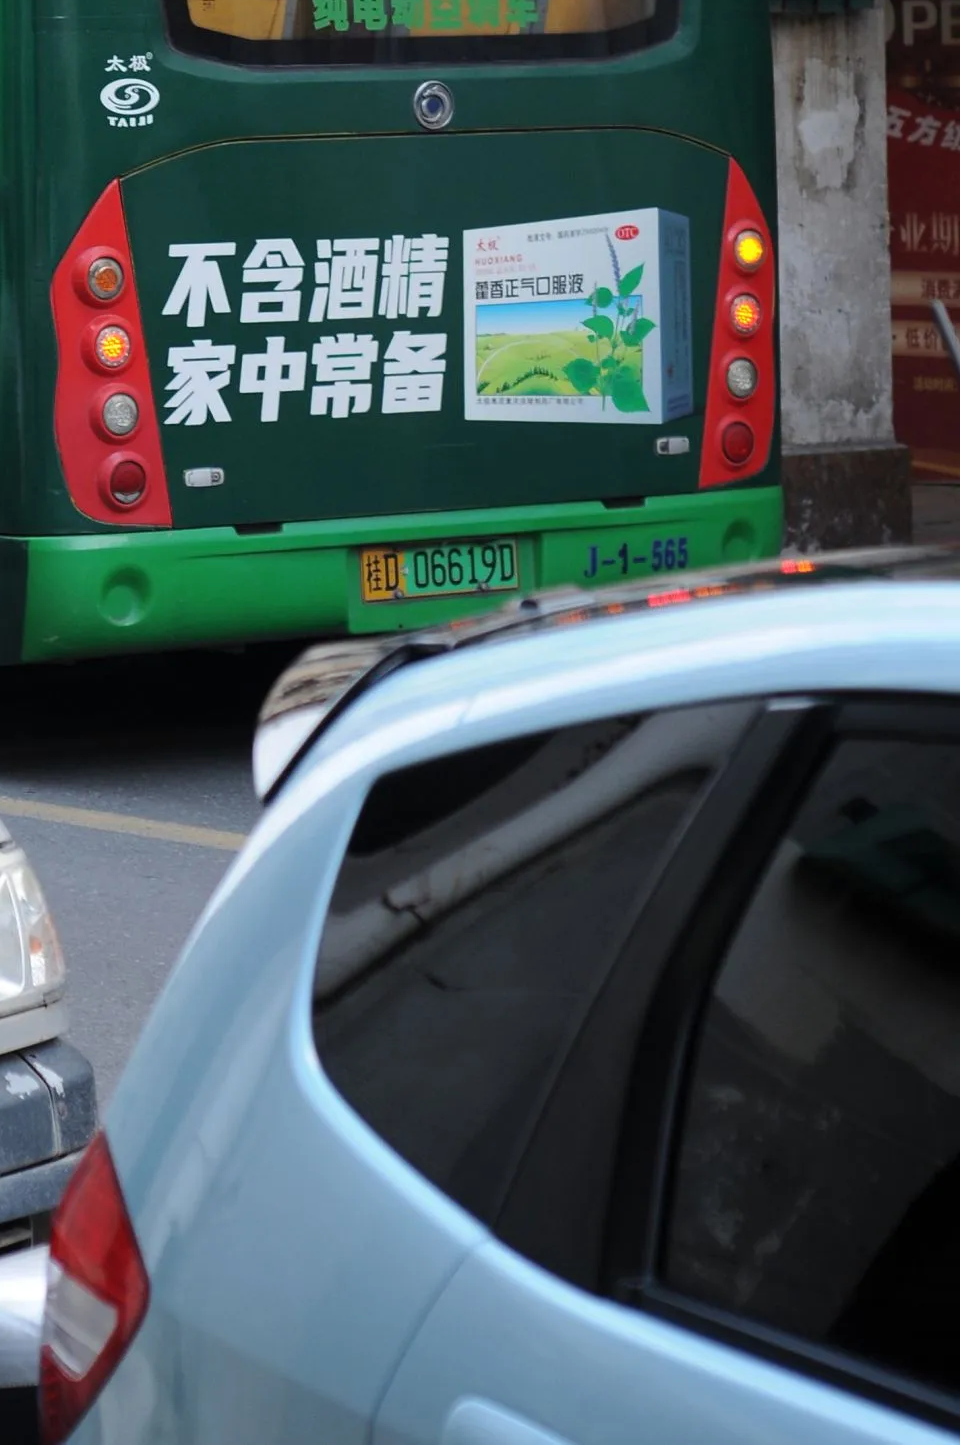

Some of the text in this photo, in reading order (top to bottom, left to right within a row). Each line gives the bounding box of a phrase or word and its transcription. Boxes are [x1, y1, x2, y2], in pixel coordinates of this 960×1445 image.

[104, 55, 151, 72] 太极
[617, 227, 638, 239] OTC
[161, 234, 450, 328] 不含酒精
[475, 273, 584, 300] 藿香正气口服液
[162, 331, 448, 426] 家中常备
